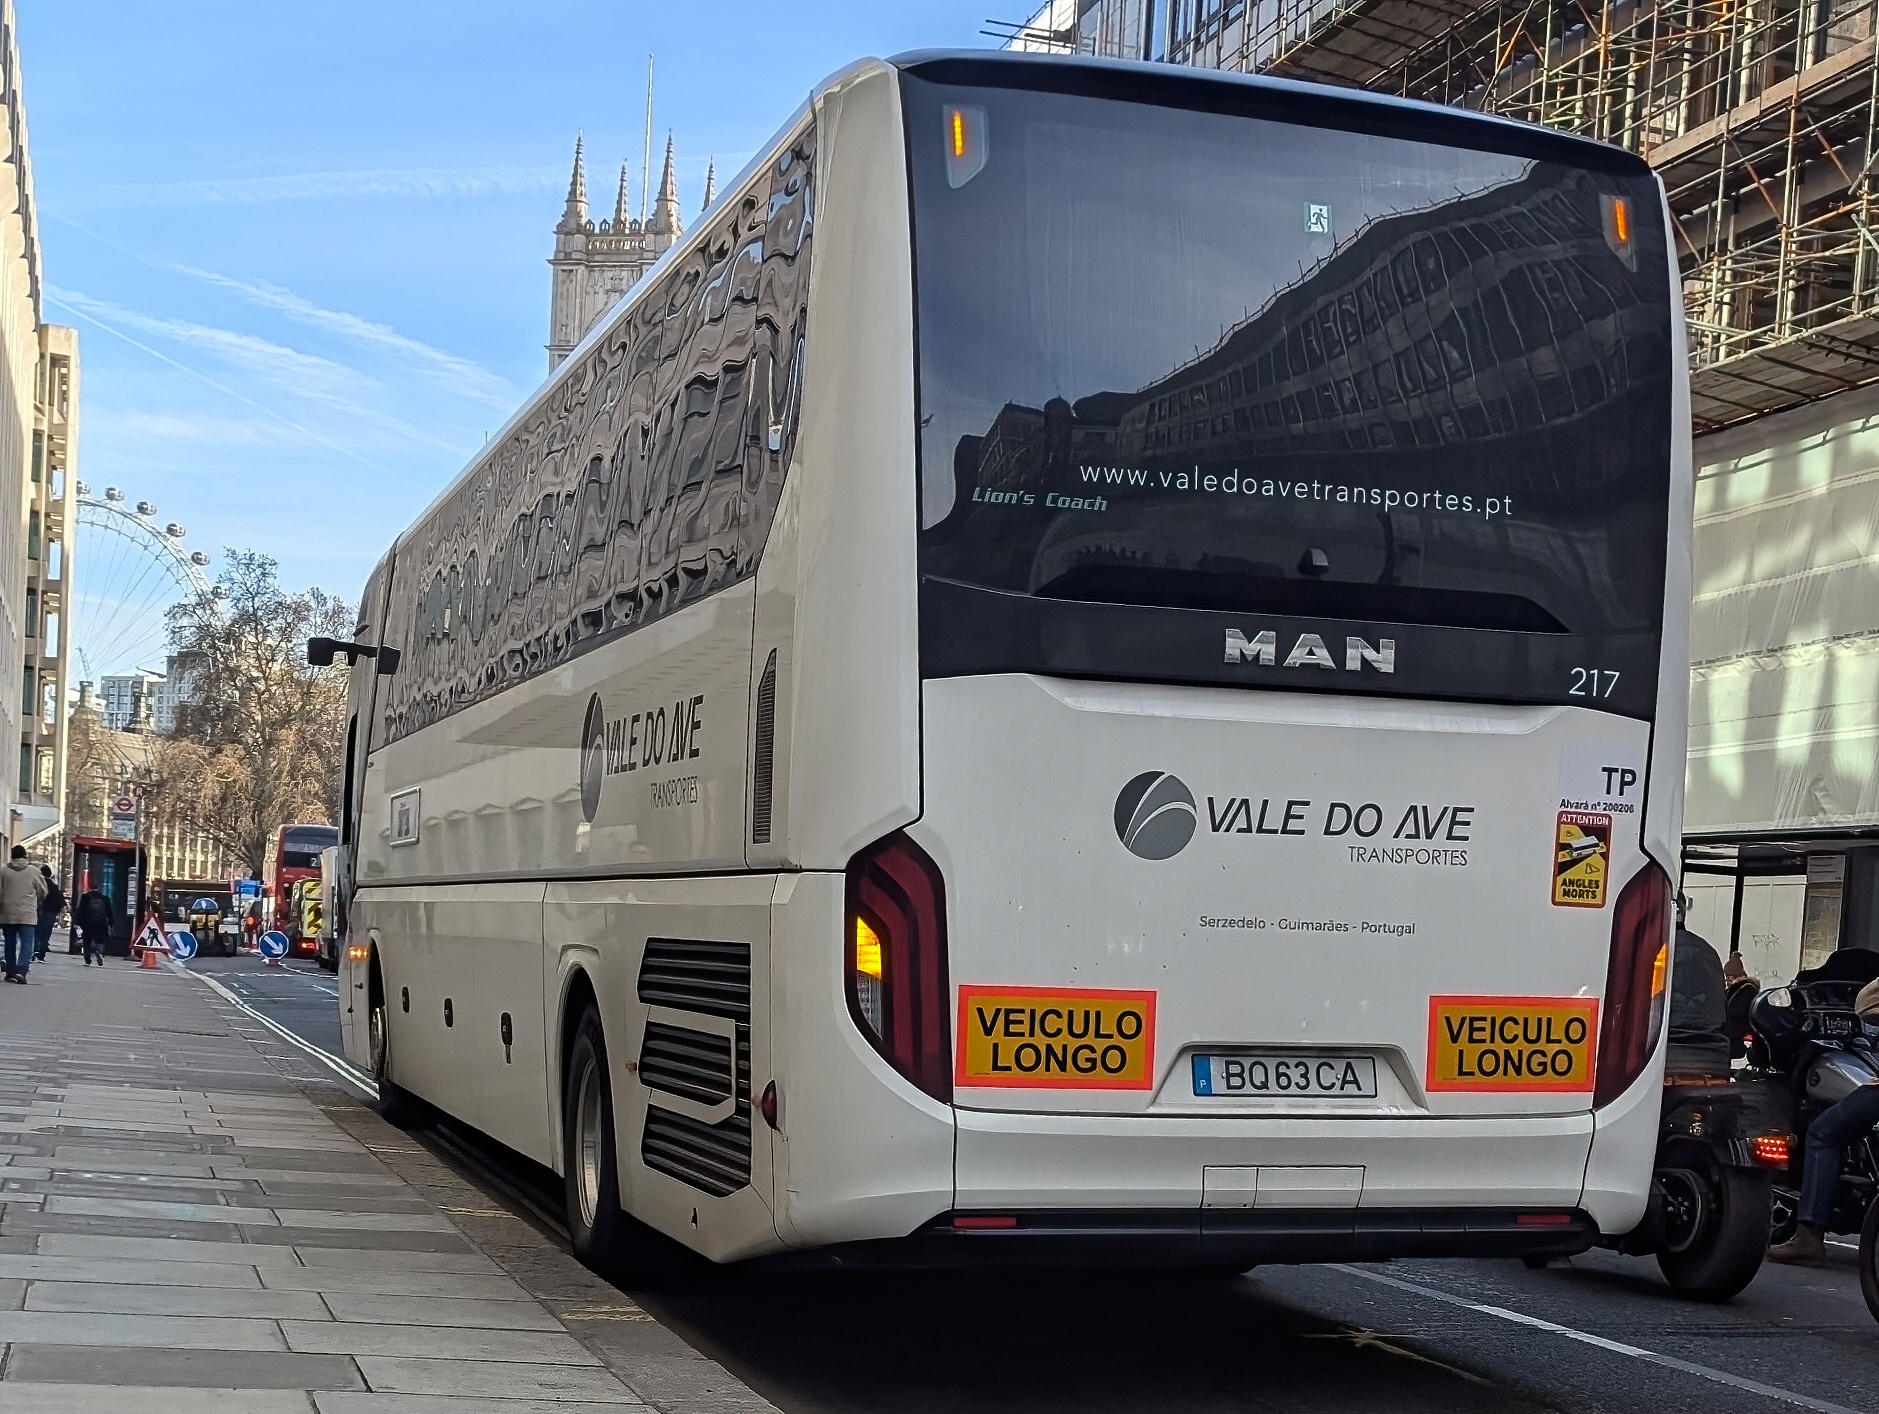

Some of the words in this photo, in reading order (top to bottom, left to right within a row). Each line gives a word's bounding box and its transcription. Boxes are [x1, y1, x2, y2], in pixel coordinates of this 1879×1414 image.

[972, 487, 1036, 505] Lion's
[1045, 493, 1108, 511] Coach
[1080, 465, 1513, 519] www.valedoavetransportes.pt
[1223, 628, 1396, 673] MAN
[1568, 666, 1621, 698] 217
[606, 713, 641, 776] VALE
[642, 706, 666, 768] DO
[667, 694, 704, 763] AVE
[651, 775, 698, 808] TRANSPORTES
[1601, 766, 1637, 797] TP
[1206, 796, 1311, 836] VALE
[1322, 802, 1384, 838] DO
[1392, 804, 1476, 842] AVE
[1560, 814, 1609, 825] ATTENTION
[1347, 845, 1469, 867] TRANSPORTES
[1561, 877, 1600, 889] ANGLES
[1562, 888, 1597, 900] MORTS
[1199, 916, 1266, 930] Serzedelo
[1278, 918, 1349, 932] Guimarães
[1361, 920, 1416, 937] Portugal
[976, 1006, 1143, 1040] VEICULO
[1444, 1016, 1587, 1045] VEICULO
[991, 1042, 1127, 1074] LONGO
[1457, 1049, 1573, 1077] LONGO
[1199, 1079, 1207, 1089] P
